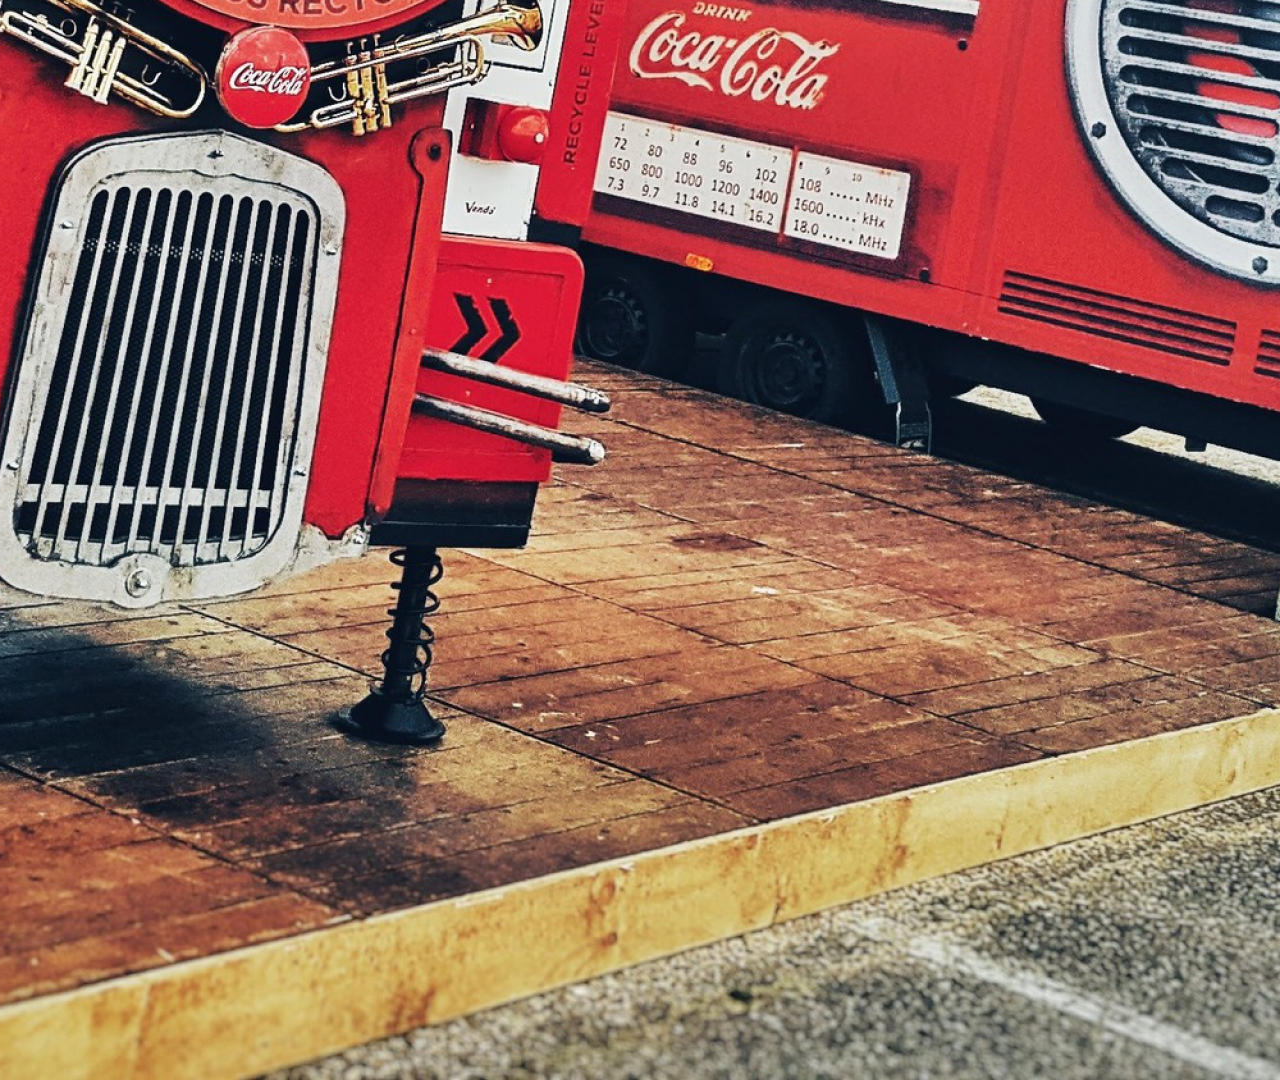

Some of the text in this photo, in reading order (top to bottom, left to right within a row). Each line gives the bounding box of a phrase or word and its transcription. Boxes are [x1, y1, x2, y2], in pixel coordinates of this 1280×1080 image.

[692, 1, 752, 22] DRINK
[229, 62, 308, 96] Coca-Cola
[629, 10, 841, 110] Coca-Cola
[563, 66, 591, 165] RECYCLE
[609, 156, 631, 172] 650
[641, 163, 663, 179] 800
[674, 171, 703, 188] 1000
[711, 179, 741, 197] 1200
[749, 188, 779, 205] 1400
[794, 197, 824, 215] 1600
[613, 136, 628, 151] 72
[647, 144, 663, 158] 80
[683, 151, 698, 166] 88
[719, 159, 733, 174] 96
[755, 168, 777, 184] 102
[799, 177, 822, 193] 108
[865, 192, 894, 208] MHz
[607, 176, 625, 191] 7.3
[641, 183, 660, 198] 9.7
[674, 192, 700, 208] 11.8
[711, 200, 735, 217] 14.1
[748, 209, 774, 226] 16.2
[793, 219, 819, 236] 18.0
[858, 233, 888, 251] MHz
